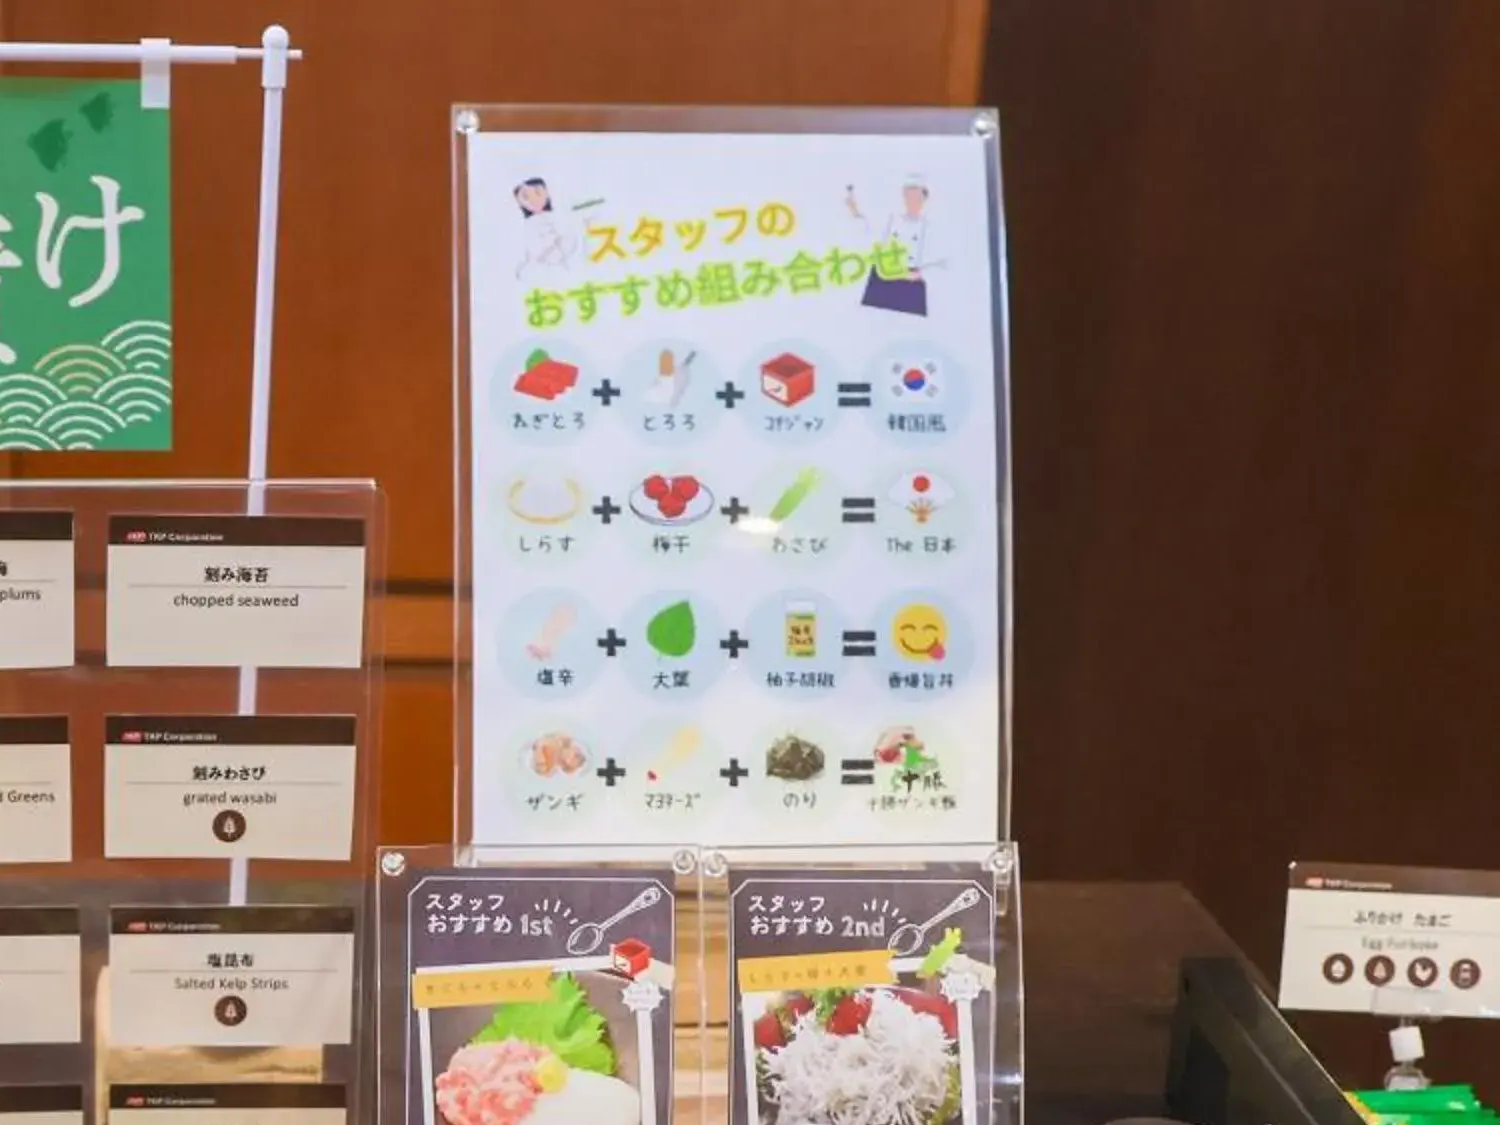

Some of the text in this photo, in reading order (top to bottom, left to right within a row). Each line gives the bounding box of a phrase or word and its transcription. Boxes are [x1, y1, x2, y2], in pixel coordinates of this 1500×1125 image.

[587, 202, 796, 264] スタッフの
[524, 240, 910, 328] おすすめ組み合わせ
[644, 414, 696, 431] とろろ
[519, 536, 575, 553] しらす
[924, 536, 956, 553] 日本
[205, 567, 269, 582] 刻み海苔
[0, 589, 41, 601] plums
[174, 596, 299, 607] chopped seaweed
[7, 792, 55, 803] Greens
[183, 793, 277, 805] grated wasabi
[783, 792, 816, 807] のり
[427, 894, 504, 910] スタッフ
[750, 896, 825, 912] スタッフ
[426, 914, 554, 937] おすすめ 1st
[752, 916, 885, 937] おすすめ 2nd
[175, 978, 288, 990] Salted Kelp Strips
